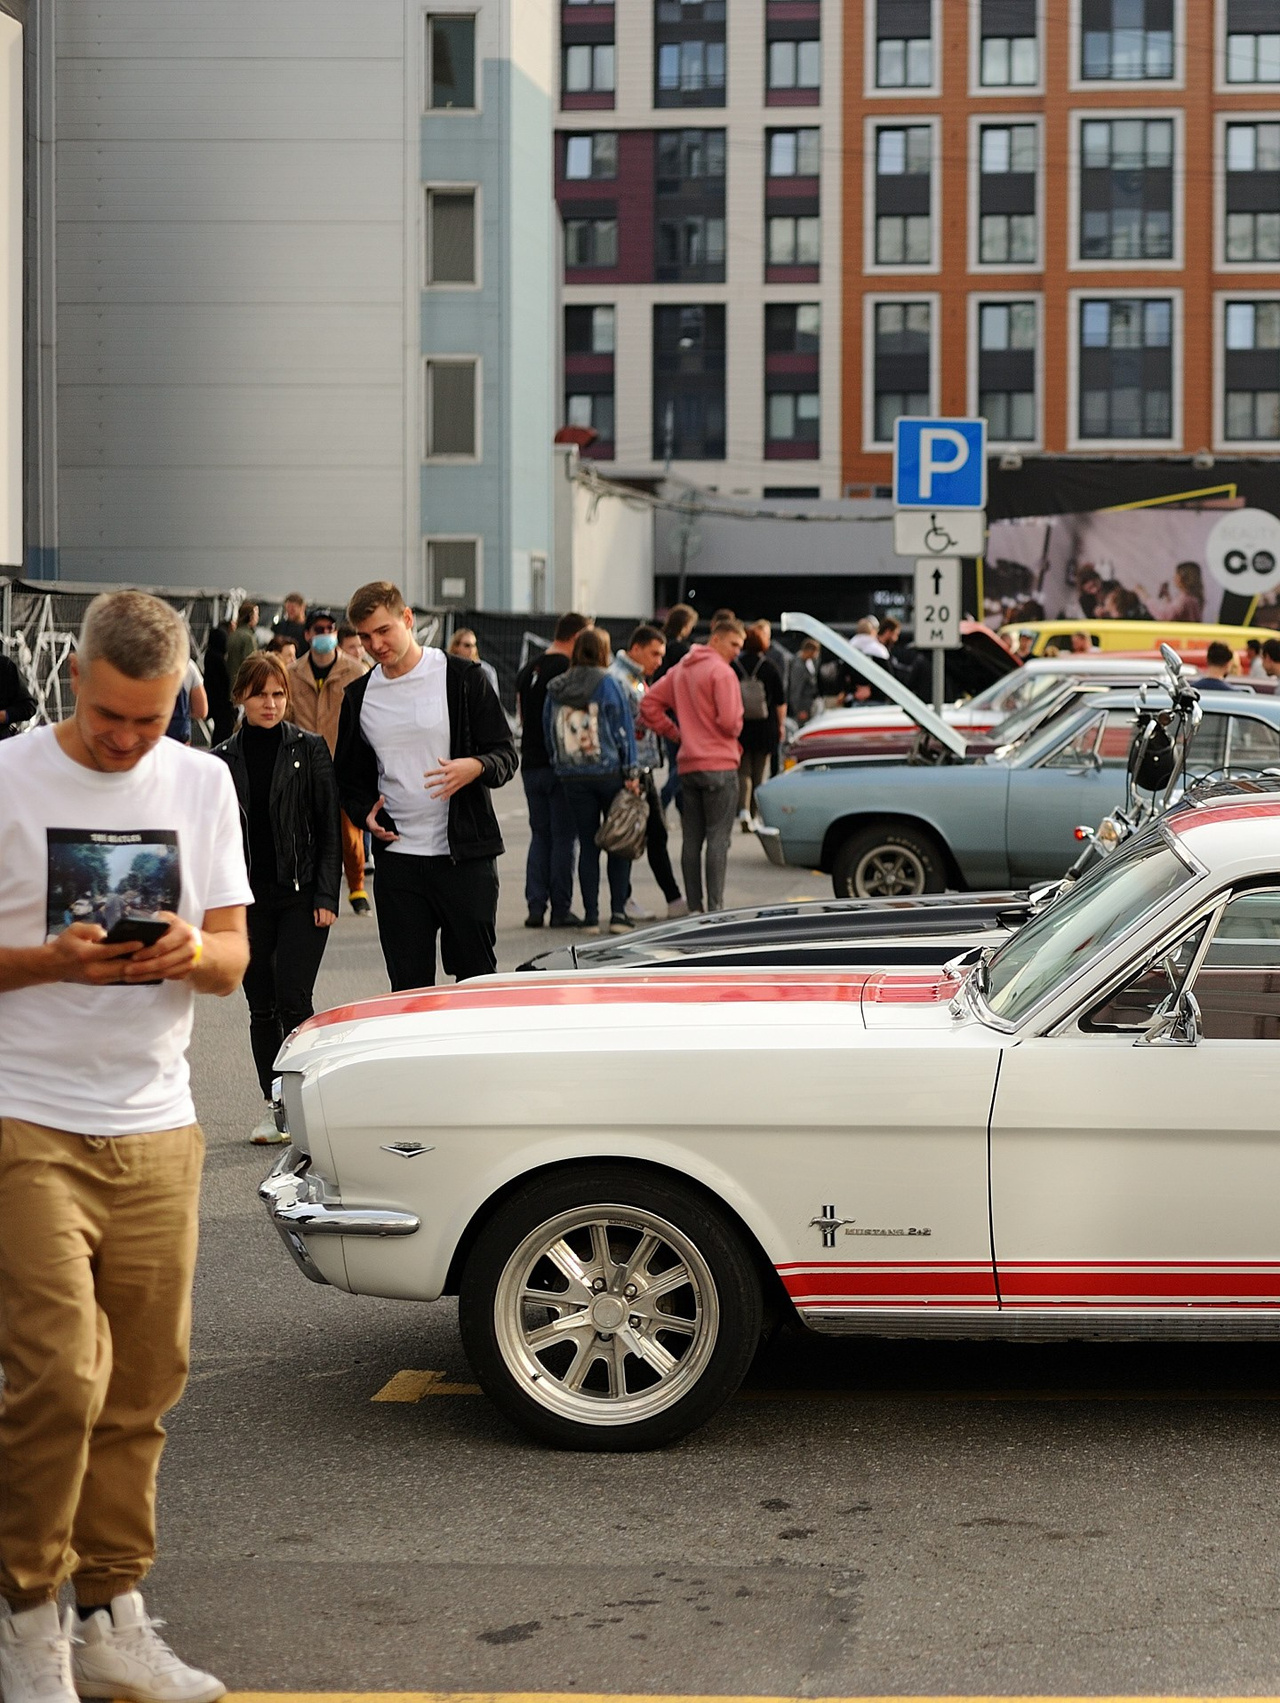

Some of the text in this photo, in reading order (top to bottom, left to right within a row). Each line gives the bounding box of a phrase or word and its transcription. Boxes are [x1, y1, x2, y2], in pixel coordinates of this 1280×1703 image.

[919, 428, 970, 499] P
[925, 605, 950, 623] 20
[930, 629, 944, 641] М
[845, 1227, 932, 1236] MUSTANG 2+2
